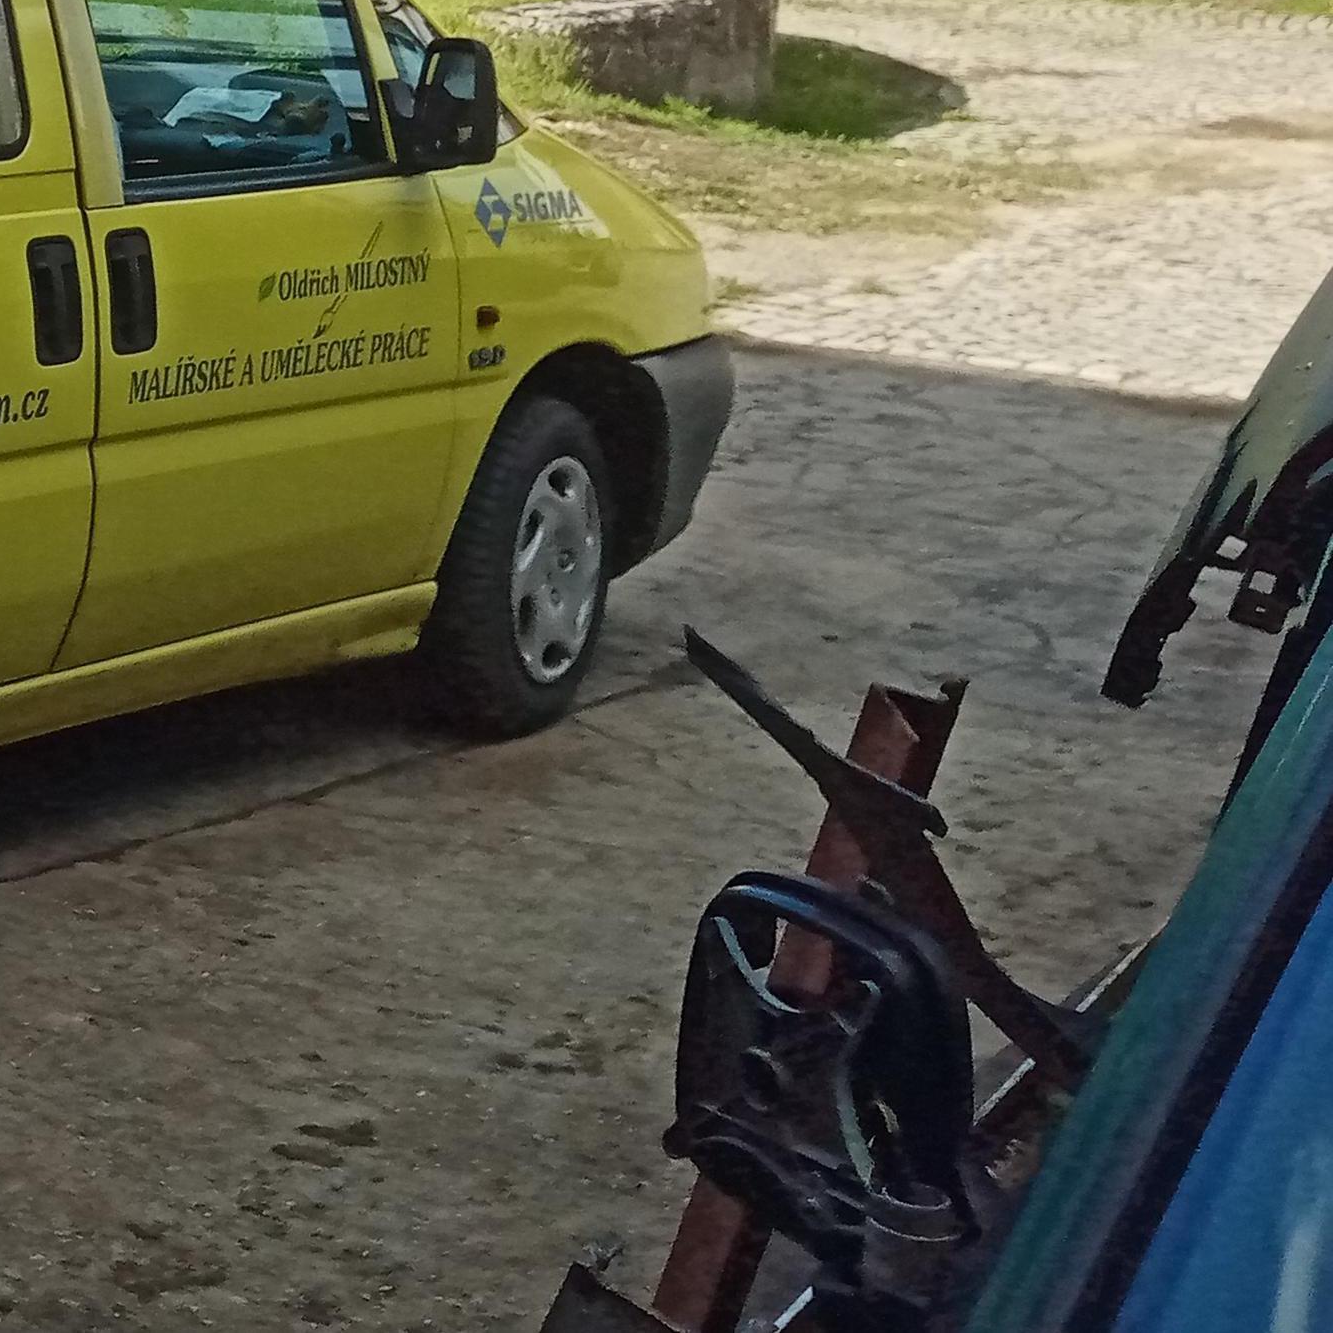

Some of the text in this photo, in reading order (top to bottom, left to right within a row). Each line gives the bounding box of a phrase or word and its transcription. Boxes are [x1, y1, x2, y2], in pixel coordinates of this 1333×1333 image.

[513, 189, 583, 223] SIGMA
[278, 246, 431, 301] Oldřich MILOSTNÝ
[128, 348, 237, 404] MALÍŘSKÉ
[239, 353, 254, 387] A
[260, 329, 365, 384] UMĚLECKÉ
[369, 323, 432, 364] PRÁCE
